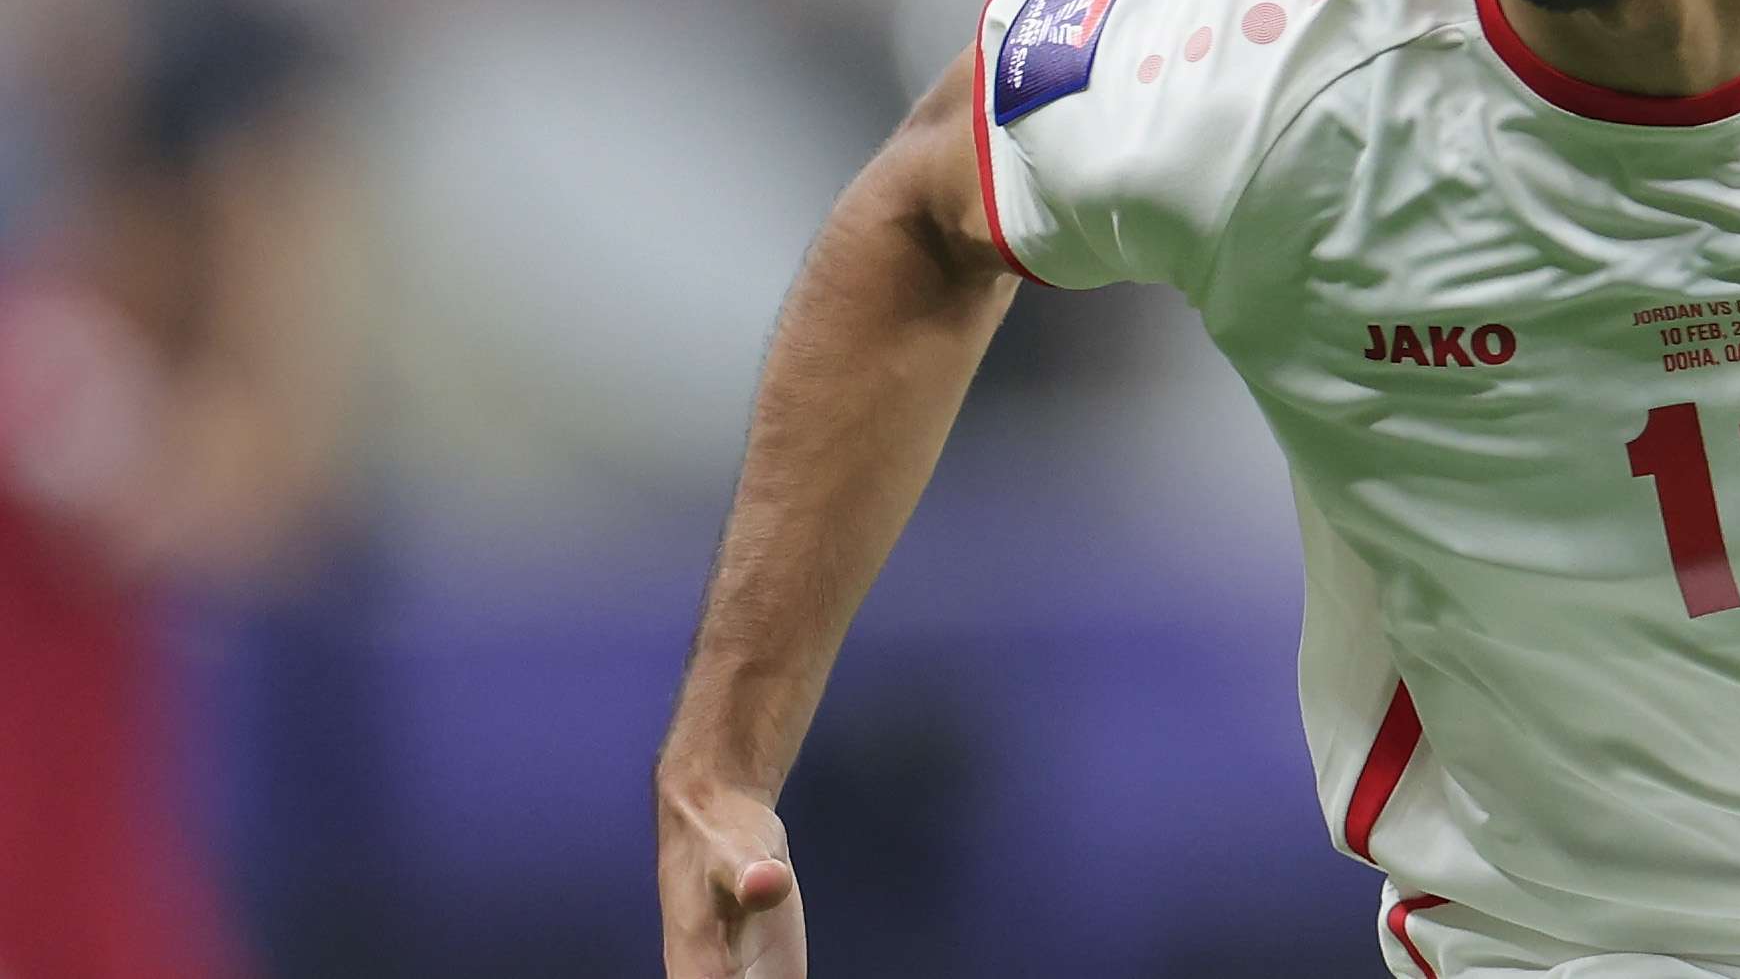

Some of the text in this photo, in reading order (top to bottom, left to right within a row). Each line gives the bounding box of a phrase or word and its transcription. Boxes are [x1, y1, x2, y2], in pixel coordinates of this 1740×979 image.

[1632, 303, 1703, 326] JORDAN
[1707, 301, 1733, 316] VS
[1364, 323, 1517, 367] JAKO
[1660, 327, 1682, 346] 10
